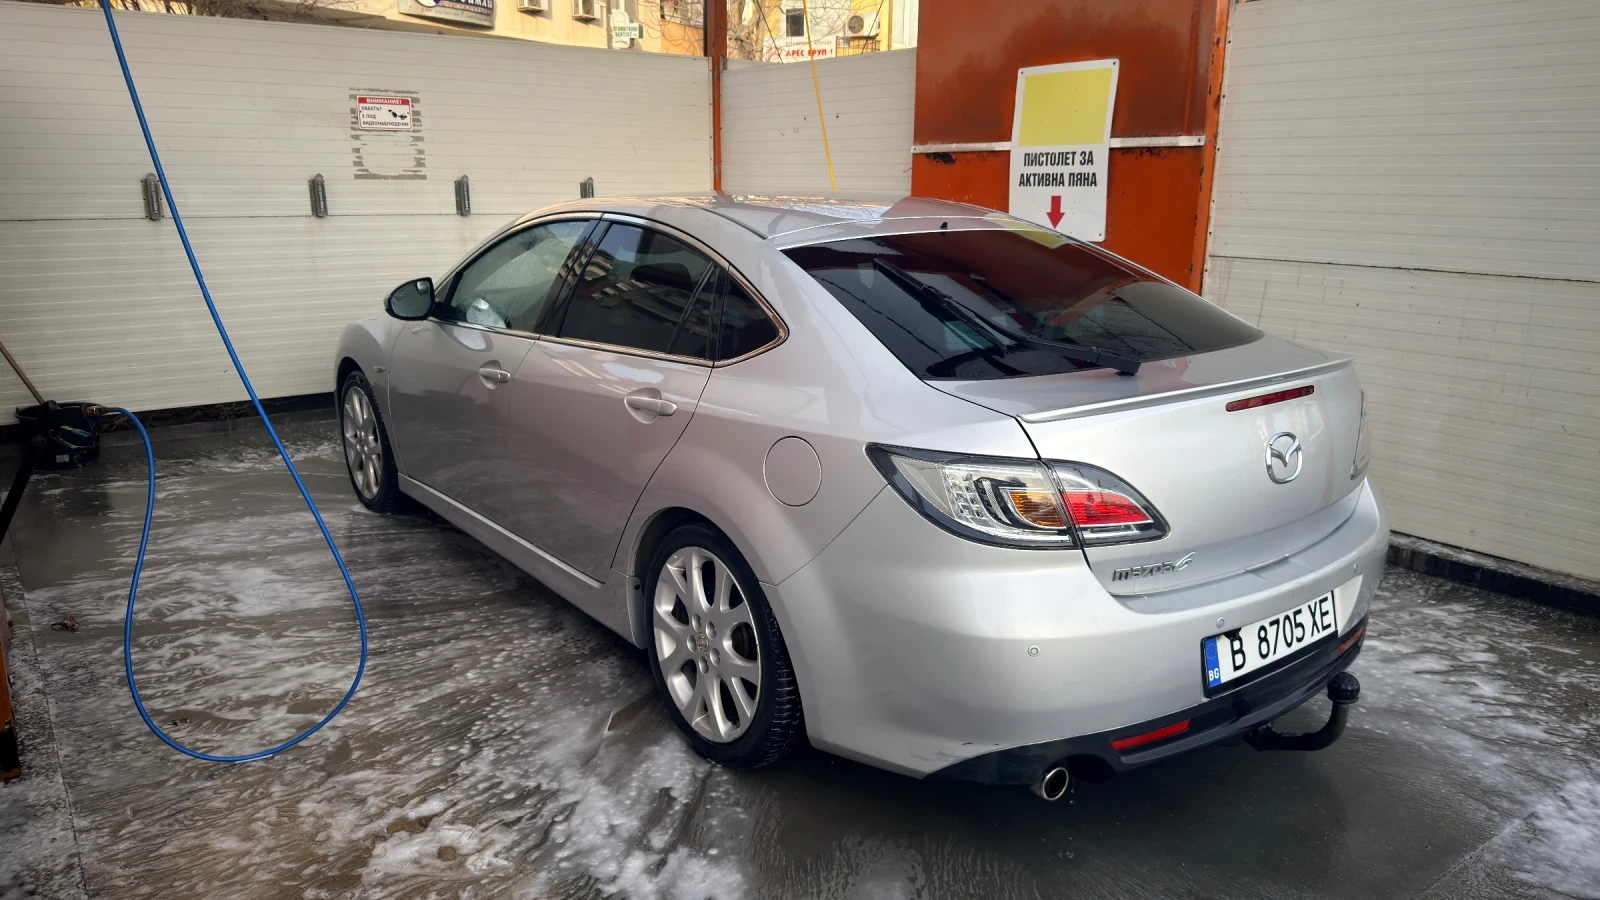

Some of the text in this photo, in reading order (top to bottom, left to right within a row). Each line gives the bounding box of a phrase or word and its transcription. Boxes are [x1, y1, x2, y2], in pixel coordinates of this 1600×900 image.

[786, 49, 804, 57] АРЕС
[1023, 151, 1094, 167] ПИСТОЛЕТ ЗА
[1019, 172, 1097, 187] АКТИВНА ПЯНА
[1257, 608, 1306, 660] 8705
[1208, 667, 1220, 681] BG
